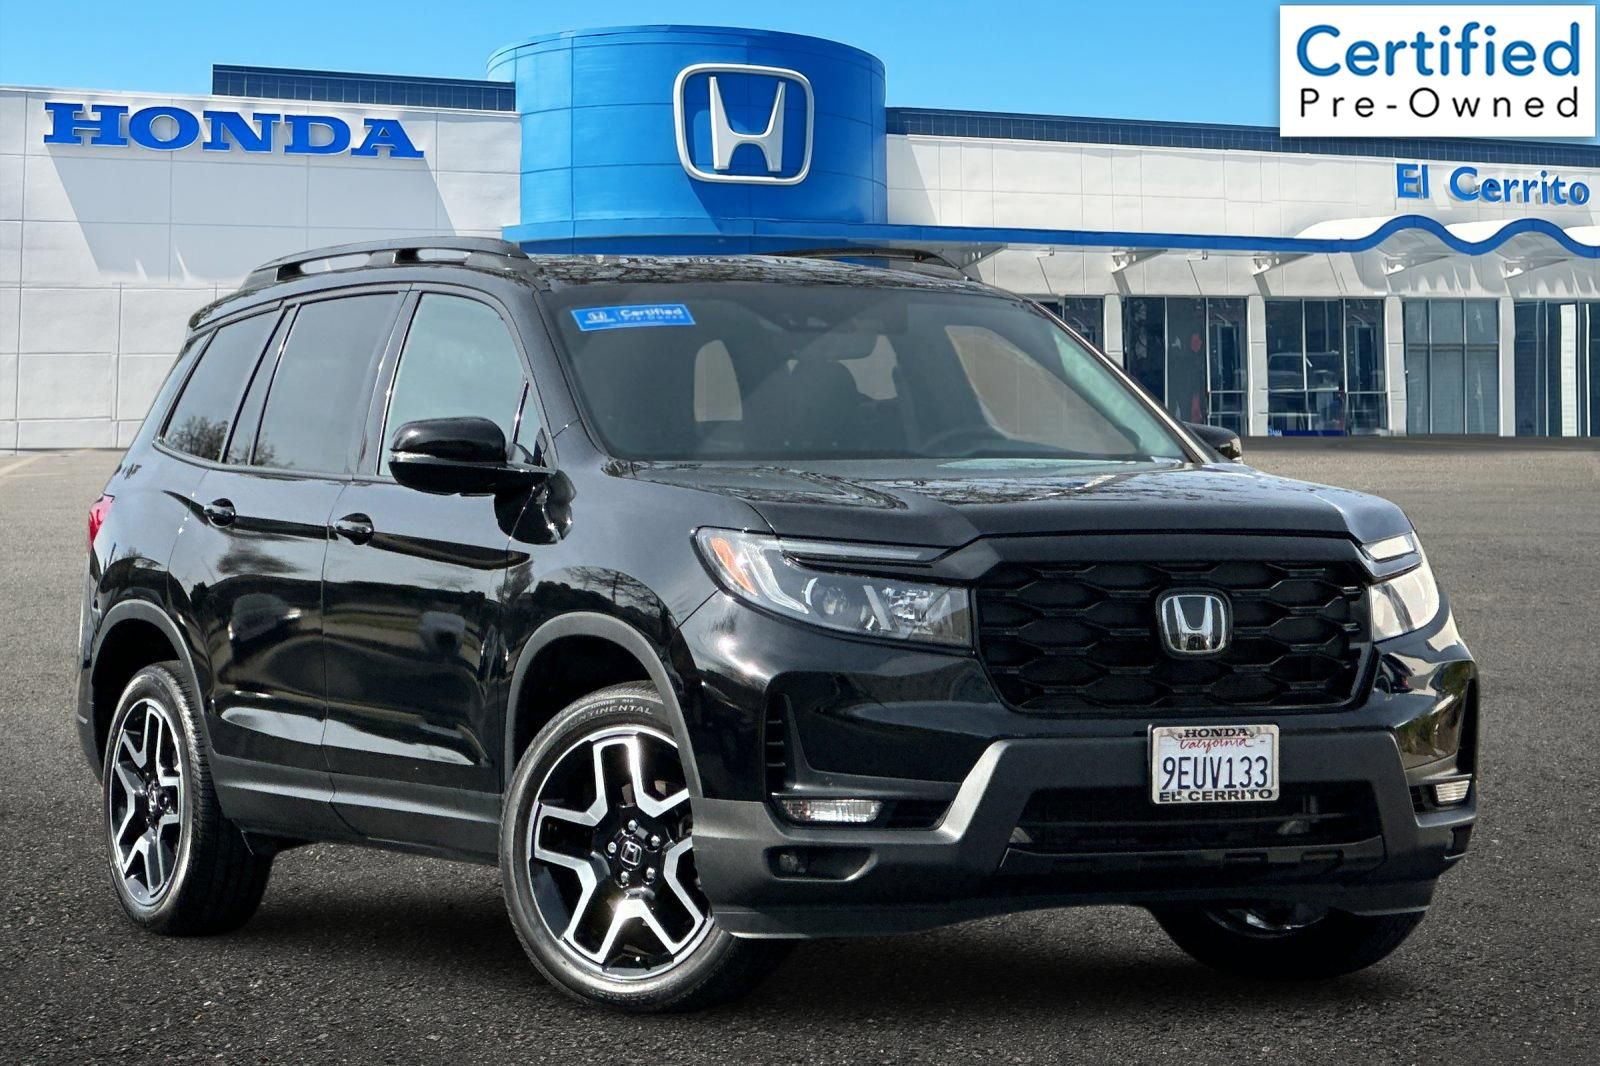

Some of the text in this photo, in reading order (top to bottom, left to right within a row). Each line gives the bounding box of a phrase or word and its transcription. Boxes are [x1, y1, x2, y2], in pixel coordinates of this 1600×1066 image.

[43, 101, 425, 159] HONDA
[1396, 162, 1591, 206] El Cerrito
[620, 307, 683, 317] Certified
[1184, 728, 1249, 738] HONDA
[1180, 737, 1254, 753] California
[1162, 755, 1268, 790] 9EUV133
[1159, 788, 1273, 802] EL CERRITO
